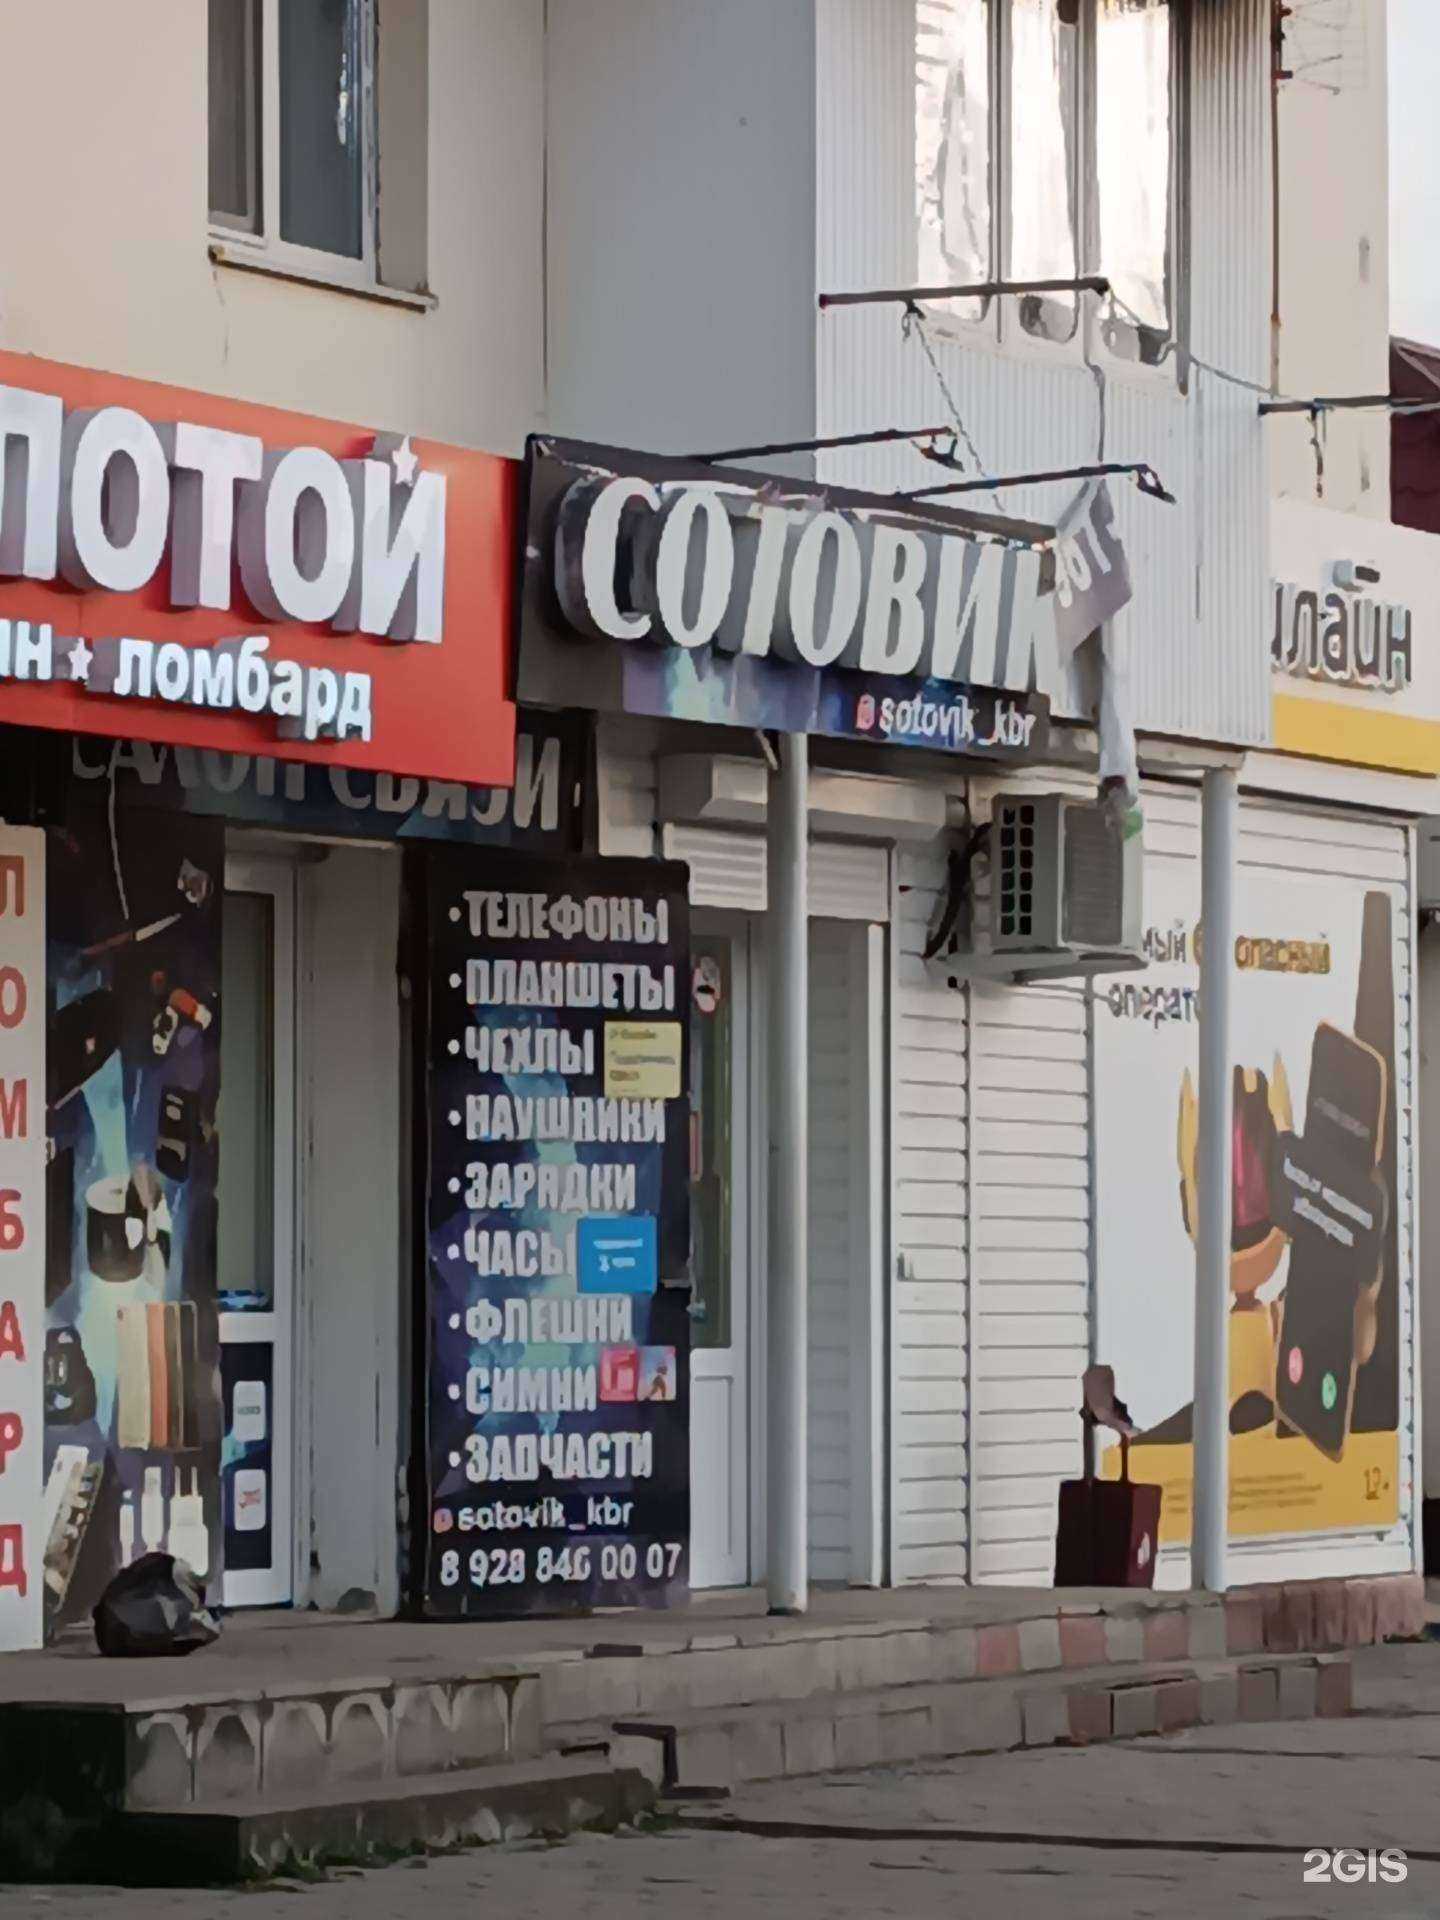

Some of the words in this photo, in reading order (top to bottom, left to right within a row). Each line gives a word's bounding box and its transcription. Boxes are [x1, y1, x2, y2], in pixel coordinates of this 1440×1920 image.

[582, 477, 1062, 694] СОТОВИК
[113, 637, 371, 742] ломбард
[463, 891, 669, 944] ТЕЛЕФОНЫ
[466, 959, 675, 1011] ПЛАНШЕТЫ
[465, 1026, 595, 1075] ЧЕХЛЫ
[466, 1095, 666, 1143] НАУШНИКИ
[464, 1162, 636, 1212] ЗАРЯДКИ
[464, 1229, 577, 1276] ЧАСЫ
[466, 1298, 632, 1344] ФЛЕШКИ
[465, 1366, 597, 1414] СИМКИ
[465, 1431, 653, 1482] ЗАПЧАСТИ
[439, 1550, 460, 1586] 8
[469, 1548, 526, 1588] 928
[601, 1542, 638, 1580] 00
[646, 1542, 682, 1579] 07
